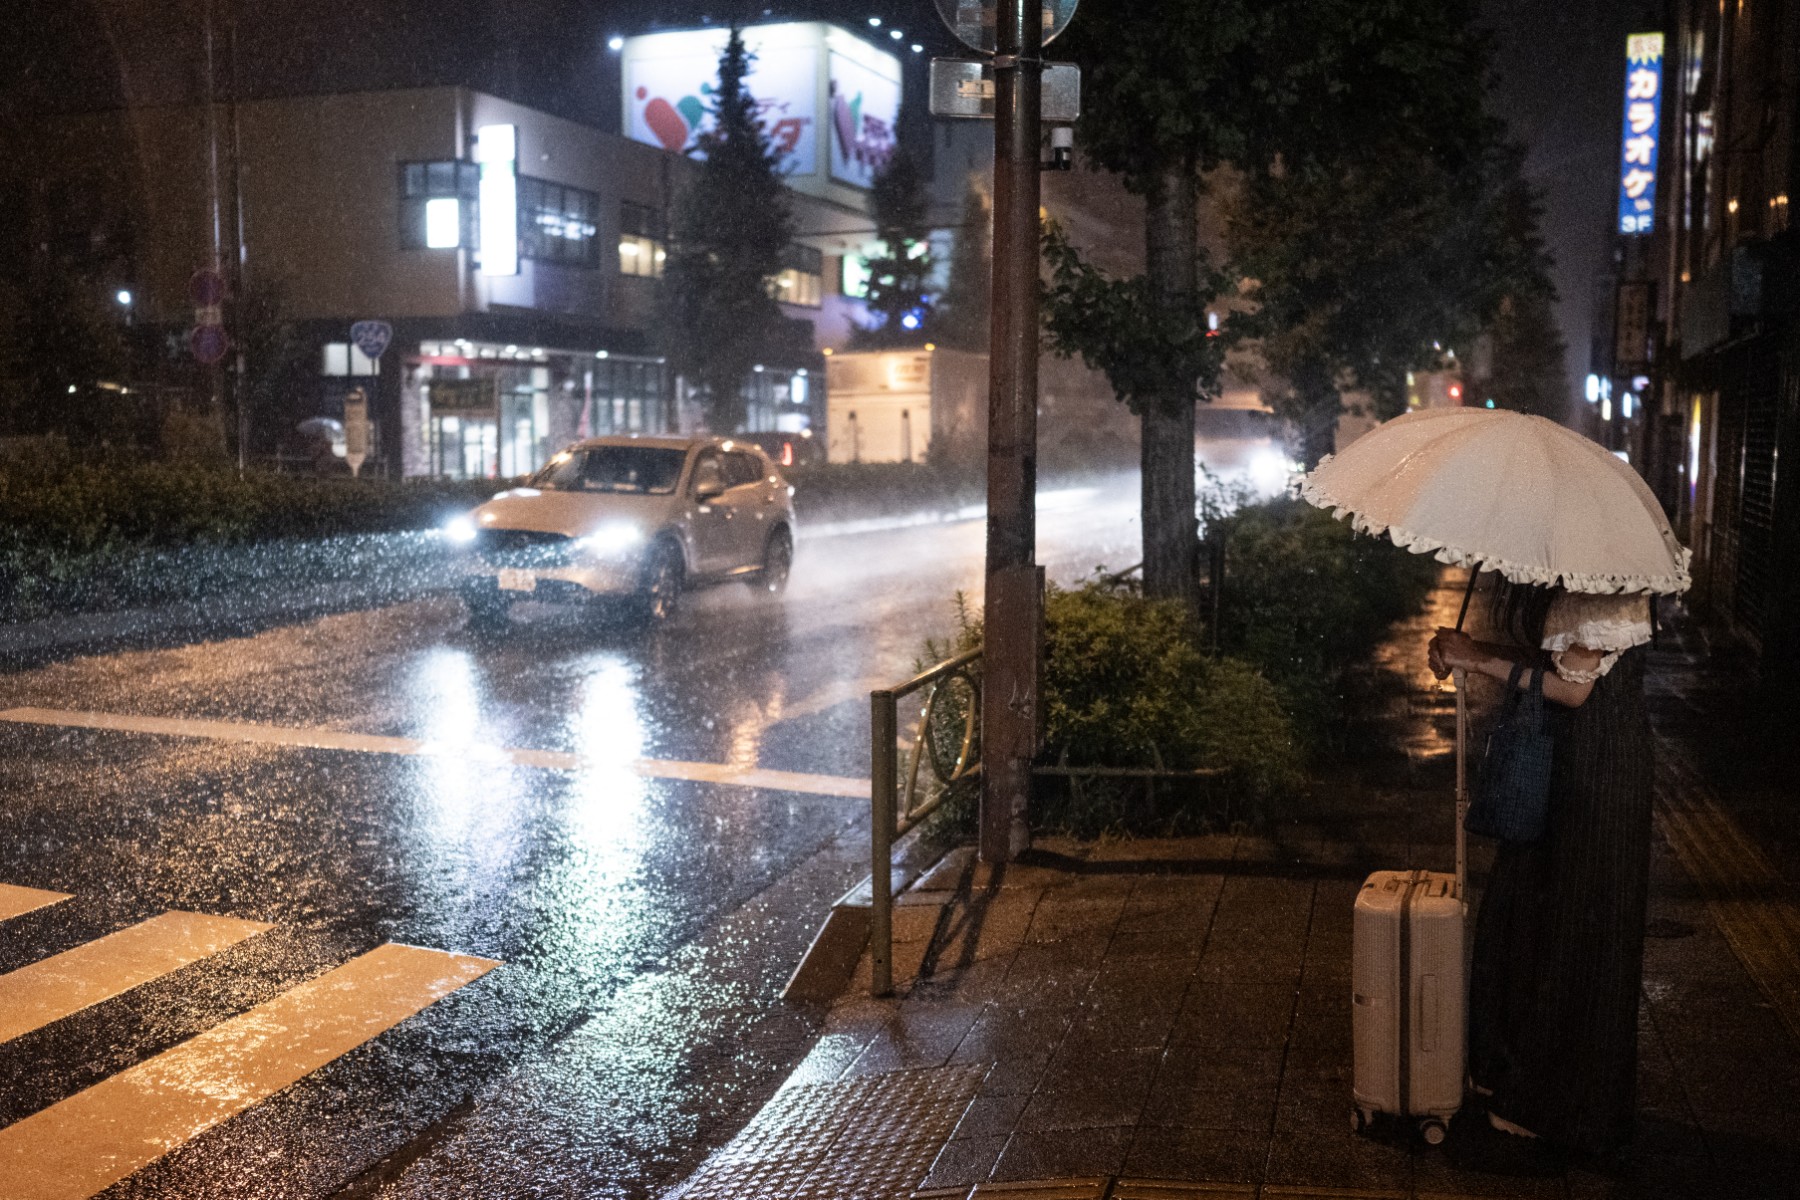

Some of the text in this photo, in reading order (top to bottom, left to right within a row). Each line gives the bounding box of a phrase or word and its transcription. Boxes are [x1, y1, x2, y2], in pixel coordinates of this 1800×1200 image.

[1623, 68, 1658, 198] カラオケ
[1621, 215, 1652, 233] 3F
